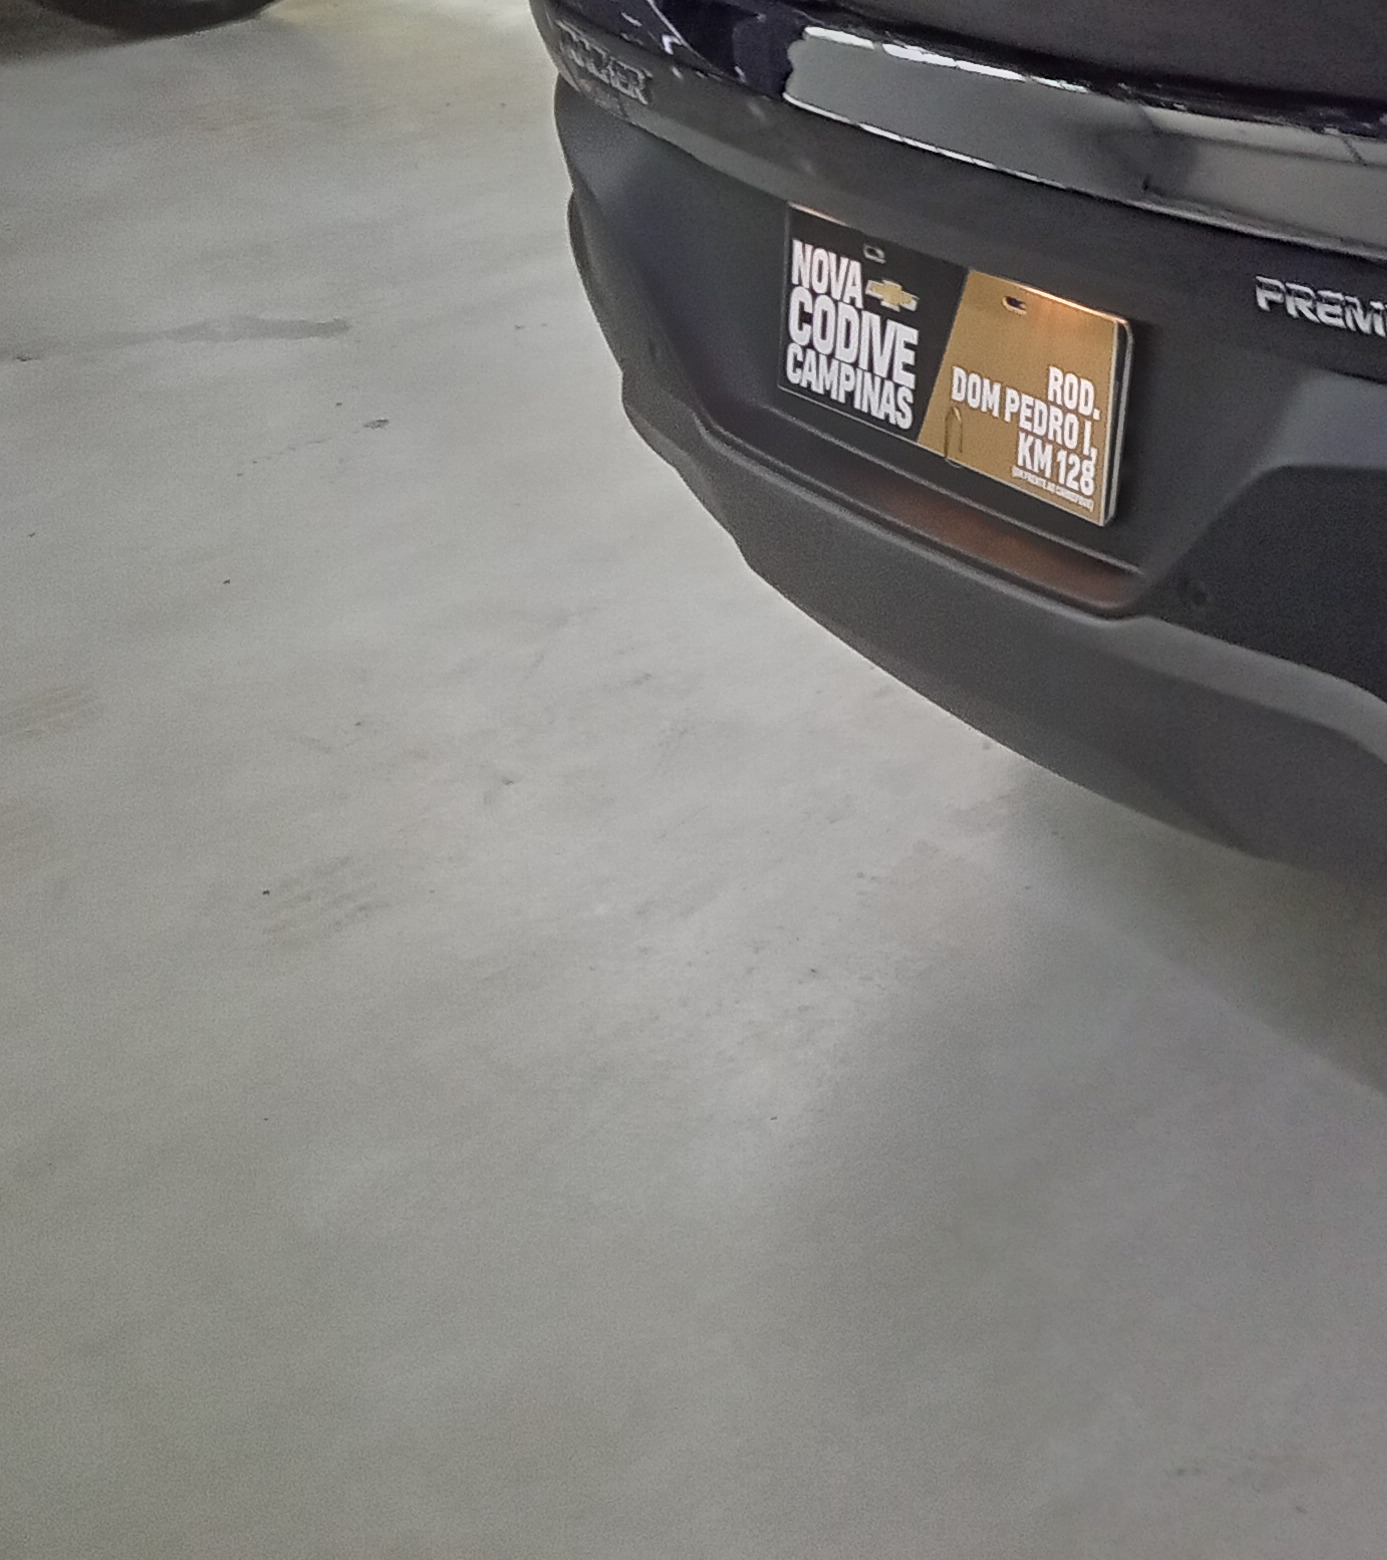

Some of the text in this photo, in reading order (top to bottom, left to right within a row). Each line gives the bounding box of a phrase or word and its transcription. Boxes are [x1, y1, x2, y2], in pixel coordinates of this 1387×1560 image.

[791, 239, 863, 309] NOVA
[788, 286, 919, 390] CODIVE
[785, 342, 913, 430] CAMPINAS
[951, 366, 1000, 419] DOM
[1004, 387, 1079, 447] PEDRO
[1047, 366, 1100, 420] ROD.
[1017, 431, 1052, 479] KM
[1056, 450, 1095, 497] 128
